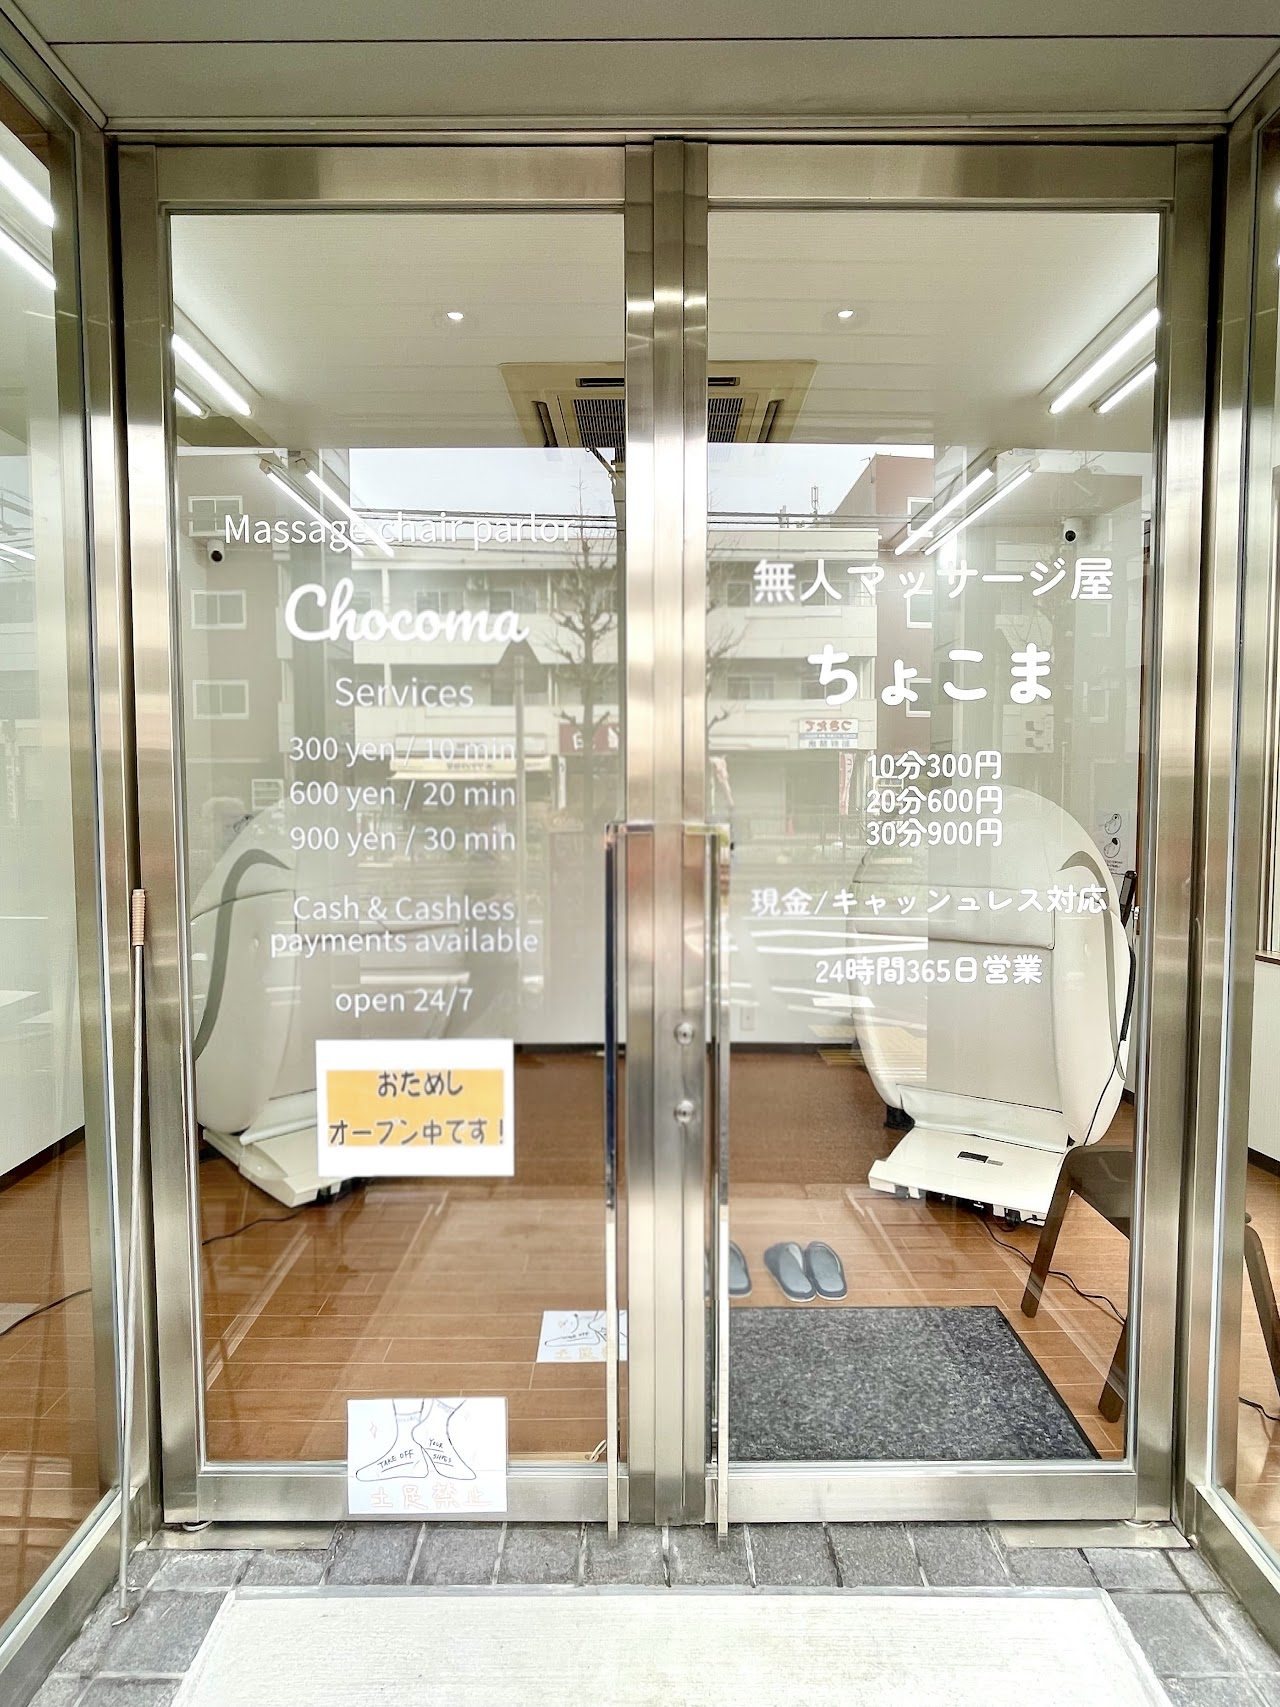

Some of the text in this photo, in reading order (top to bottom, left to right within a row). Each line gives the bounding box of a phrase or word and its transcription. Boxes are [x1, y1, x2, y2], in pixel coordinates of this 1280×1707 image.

[224, 511, 575, 552] Massage chair parlor
[752, 557, 1114, 603] 無人マッサージ屋
[284, 577, 530, 642] Chocoma
[807, 642, 1053, 706] ちょこま
[335, 677, 474, 708] Services
[289, 736, 516, 768] 300 yen / 10 min
[867, 750, 1002, 779] 10分300円
[289, 779, 516, 812] 600 yen / 20 min
[866, 785, 1003, 814] 20分600円
[289, 825, 516, 857] 900 yen / 30 min
[866, 817, 1003, 847] 30分900円
[292, 895, 515, 921] Cash & Cashless
[751, 884, 1108, 916] 現金/キャッシュレス対応
[270, 927, 539, 957] payments available
[815, 954, 1044, 985] 24時間365日営業
[335, 987, 474, 1018] open 24/7
[377, 1069, 464, 1098] おためし
[377, 1449, 414, 1469] TAKE OFF
[371, 1481, 494, 1511] 土足禁止
